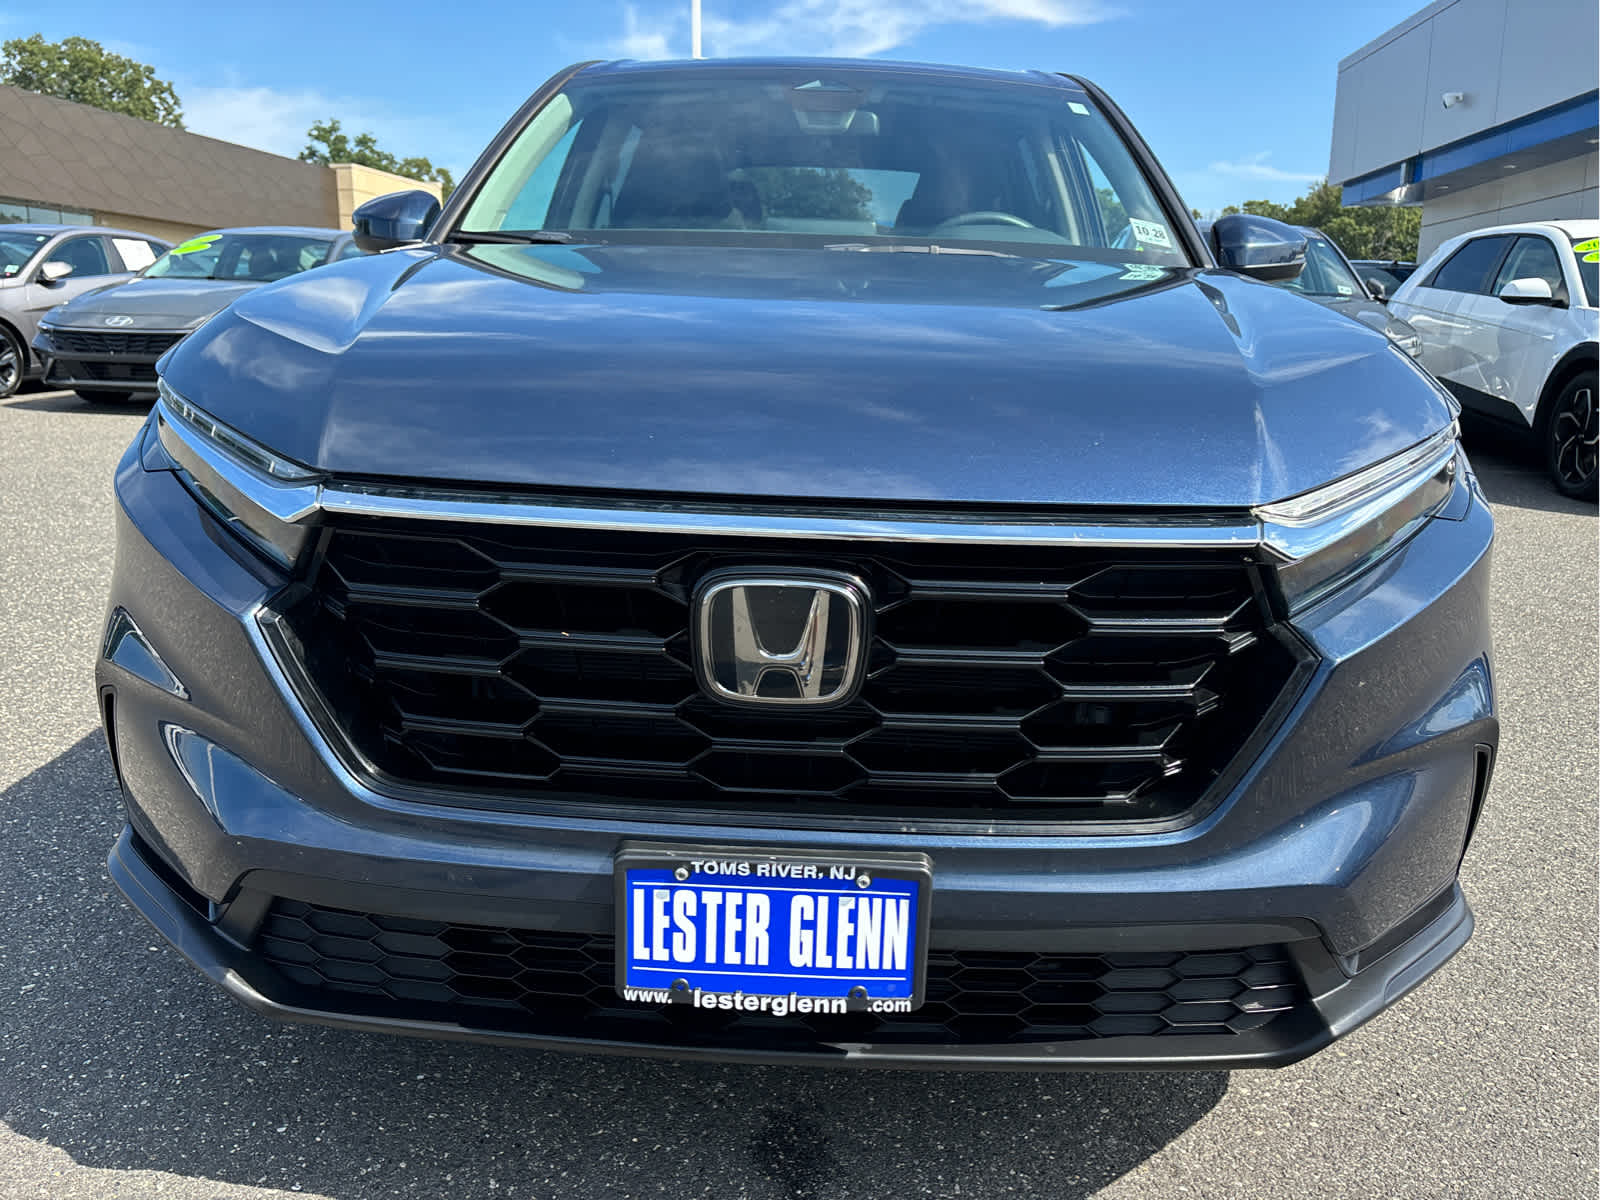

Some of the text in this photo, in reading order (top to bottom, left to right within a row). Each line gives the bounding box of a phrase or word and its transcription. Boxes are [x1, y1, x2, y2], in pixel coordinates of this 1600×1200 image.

[691, 860, 856, 881] TOMS RIVER, NJ
[633, 887, 910, 971] LESTER GLENN
[623, 987, 912, 1016] www. lesterglenn .com
